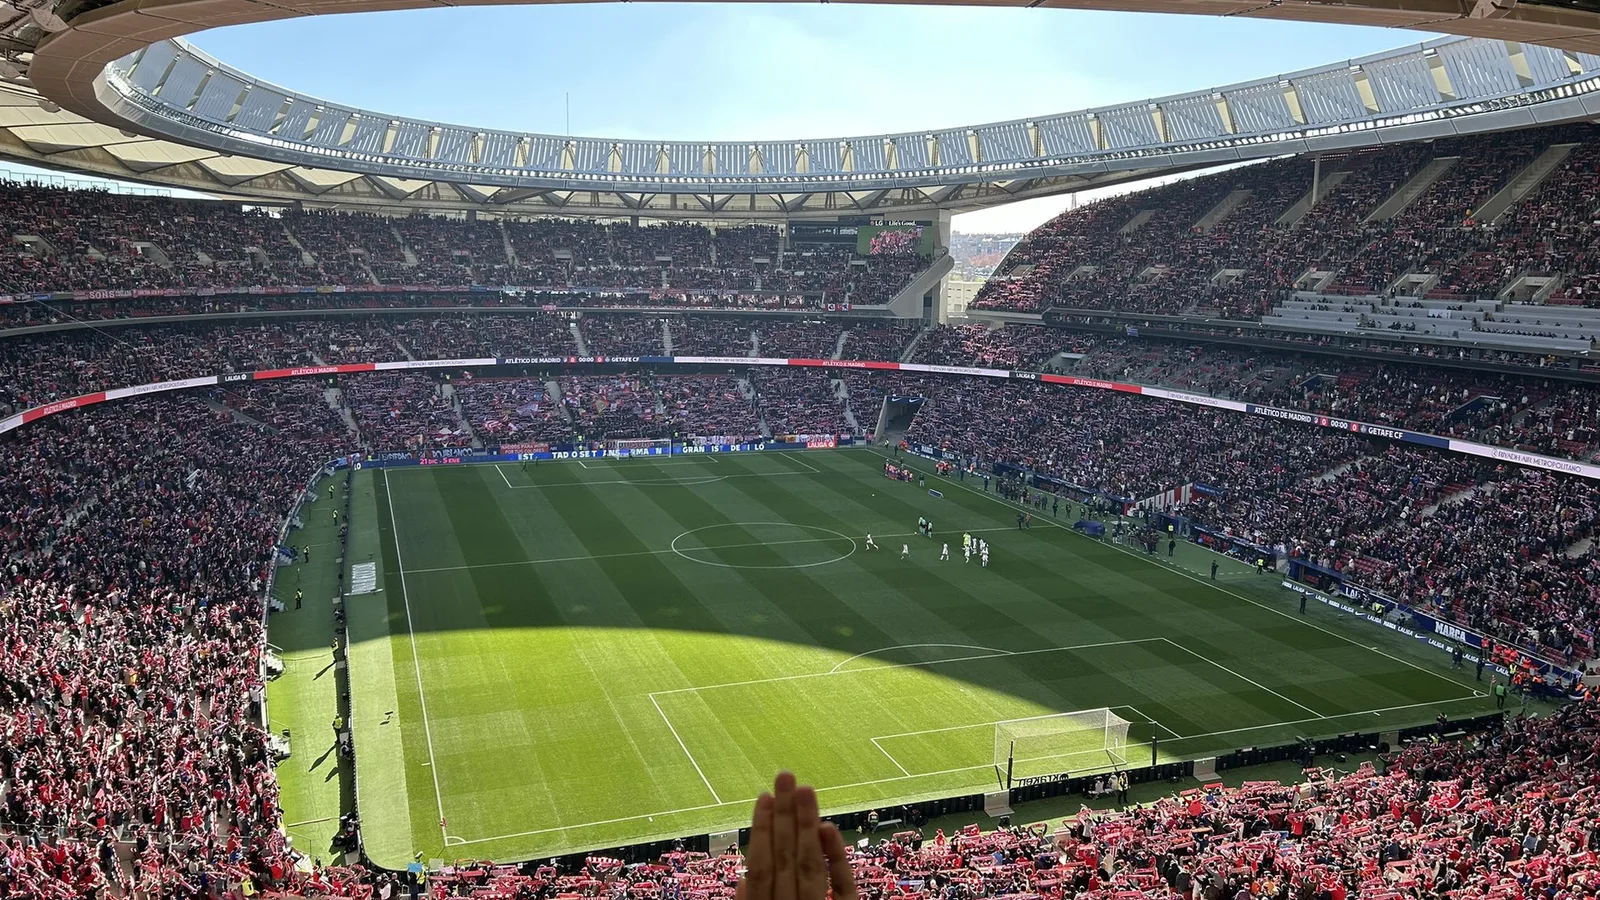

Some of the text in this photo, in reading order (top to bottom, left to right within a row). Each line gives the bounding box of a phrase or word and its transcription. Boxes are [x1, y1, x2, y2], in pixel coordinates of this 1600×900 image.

[89, 290, 115, 299] SONS
[224, 374, 241, 382] LALIGA
[1254, 406, 1280, 418] ATLÉTICO
[1288, 412, 1311, 423] MADRID
[1330, 420, 1348, 430] 00:00
[1368, 426, 1394, 438] GETAFE
[1394, 430, 1403, 439] CF
[730, 444, 740, 452] DE
[1498, 450, 1581, 473] RIYADH AIR METROPOLITANO
[1398, 626, 1414, 636] LALIGA
[1428, 638, 1444, 649] LALIGA
[1434, 621, 1467, 642] MARCA
